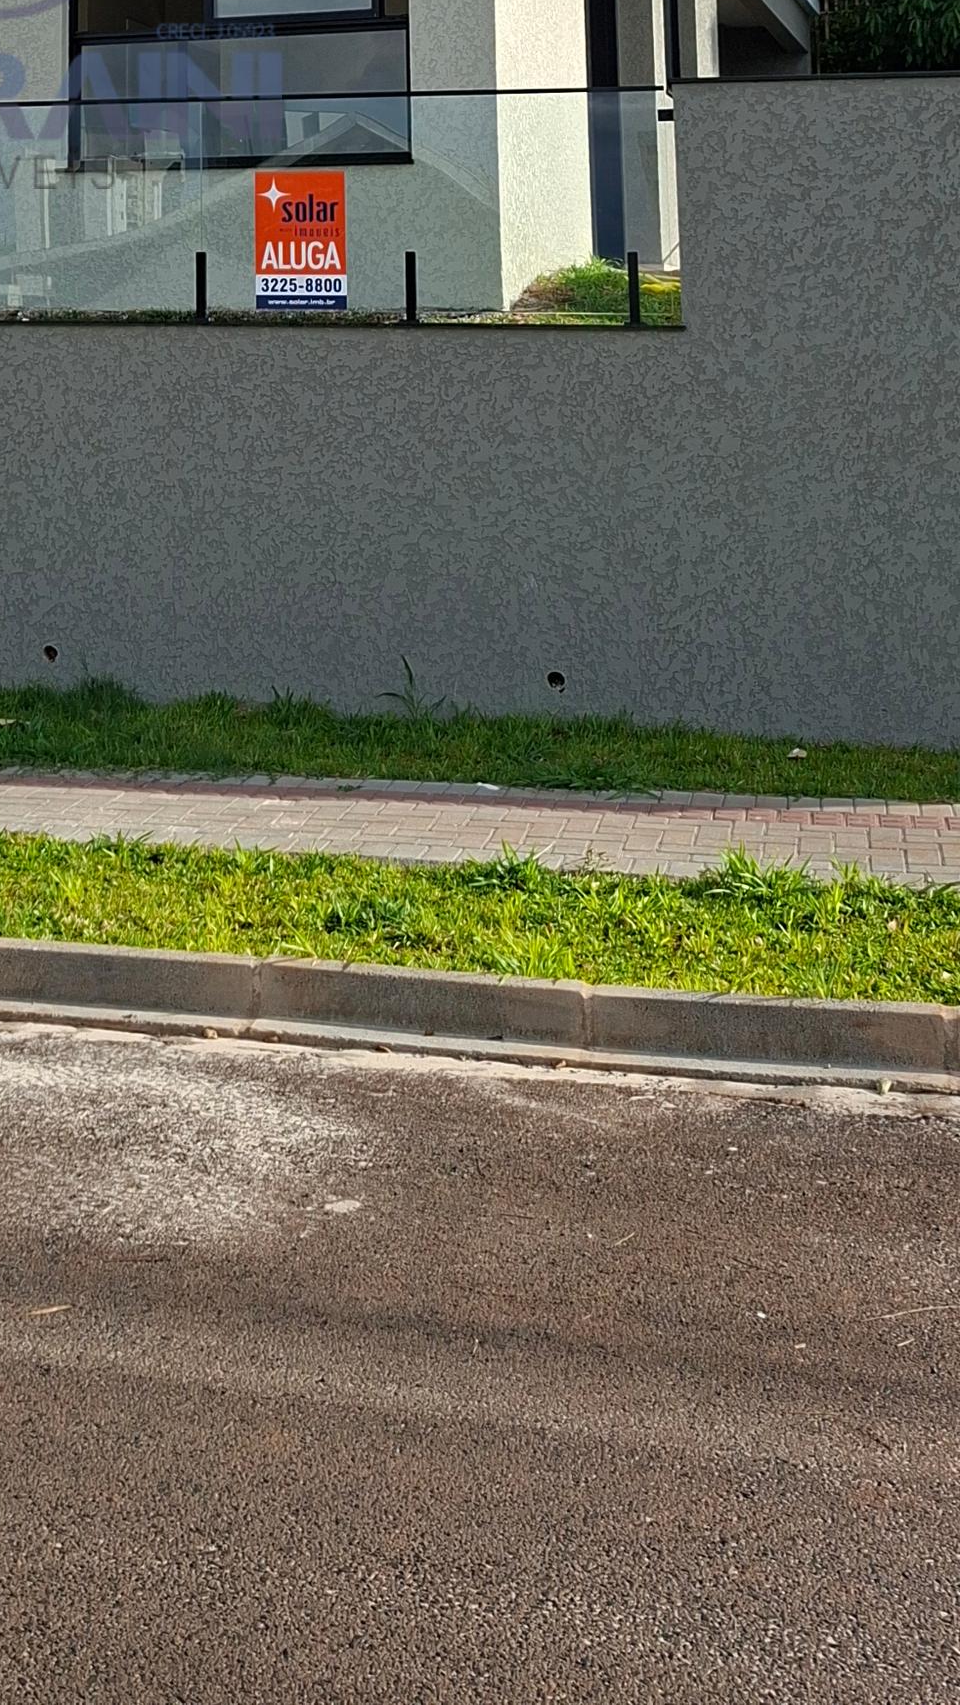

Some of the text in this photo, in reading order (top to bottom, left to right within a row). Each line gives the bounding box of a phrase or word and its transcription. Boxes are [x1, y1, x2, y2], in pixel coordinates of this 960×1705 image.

[281, 193, 339, 223] solar
[261, 240, 342, 270] ALUGA
[261, 278, 342, 293] 3225-8800
